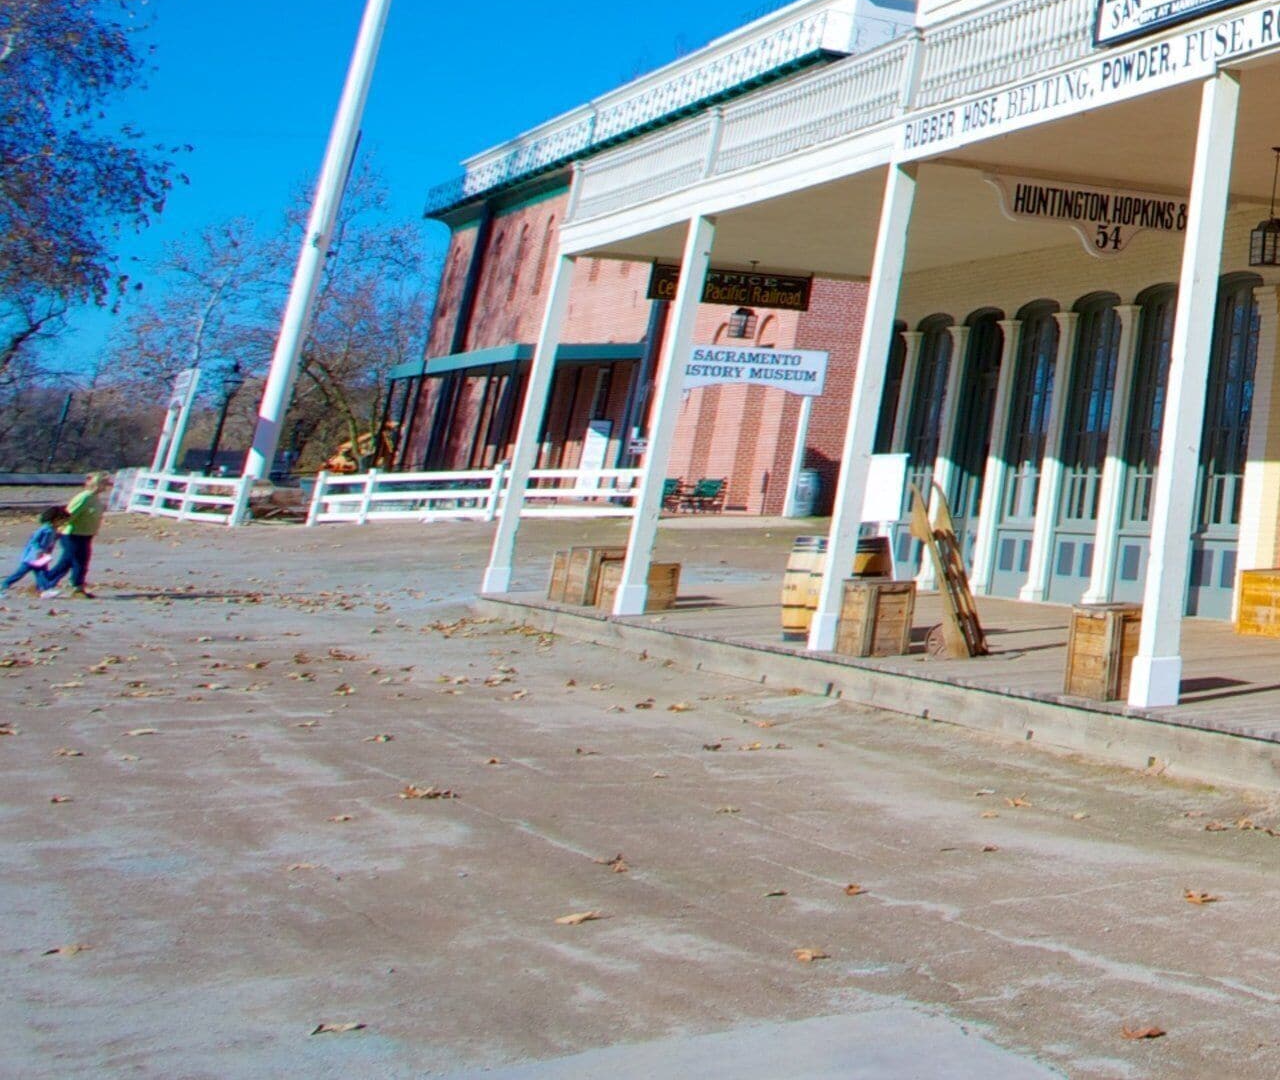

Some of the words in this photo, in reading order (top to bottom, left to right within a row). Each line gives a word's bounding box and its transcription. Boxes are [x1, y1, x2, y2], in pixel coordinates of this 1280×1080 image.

[903, 110, 955, 150] RUBBER
[1112, 195, 1175, 230] HOPKINS
[1095, 224, 1122, 250] 54
[707, 273, 778, 287] FFICE
[705, 283, 747, 301] Pacific
[752, 286, 802, 305] Railroad
[693, 349, 802, 366] SACRAMENTO
[685, 364, 745, 379] ISTORY
[748, 367, 817, 382] MUSEUM
